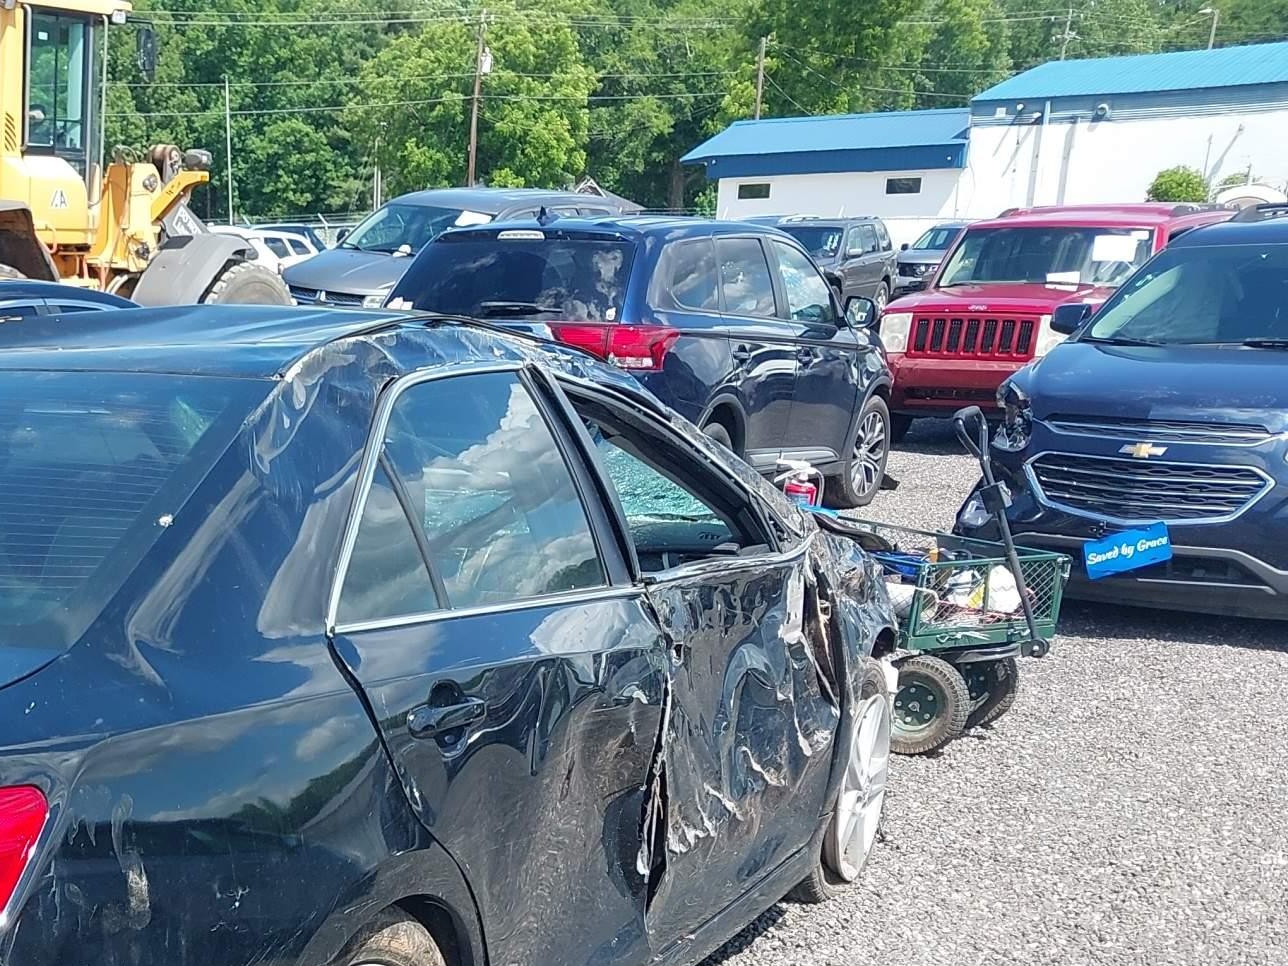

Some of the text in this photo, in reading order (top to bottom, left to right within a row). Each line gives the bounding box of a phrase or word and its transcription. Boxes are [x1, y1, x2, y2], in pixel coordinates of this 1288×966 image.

[1087, 536, 1168, 565] Saved by Grace
